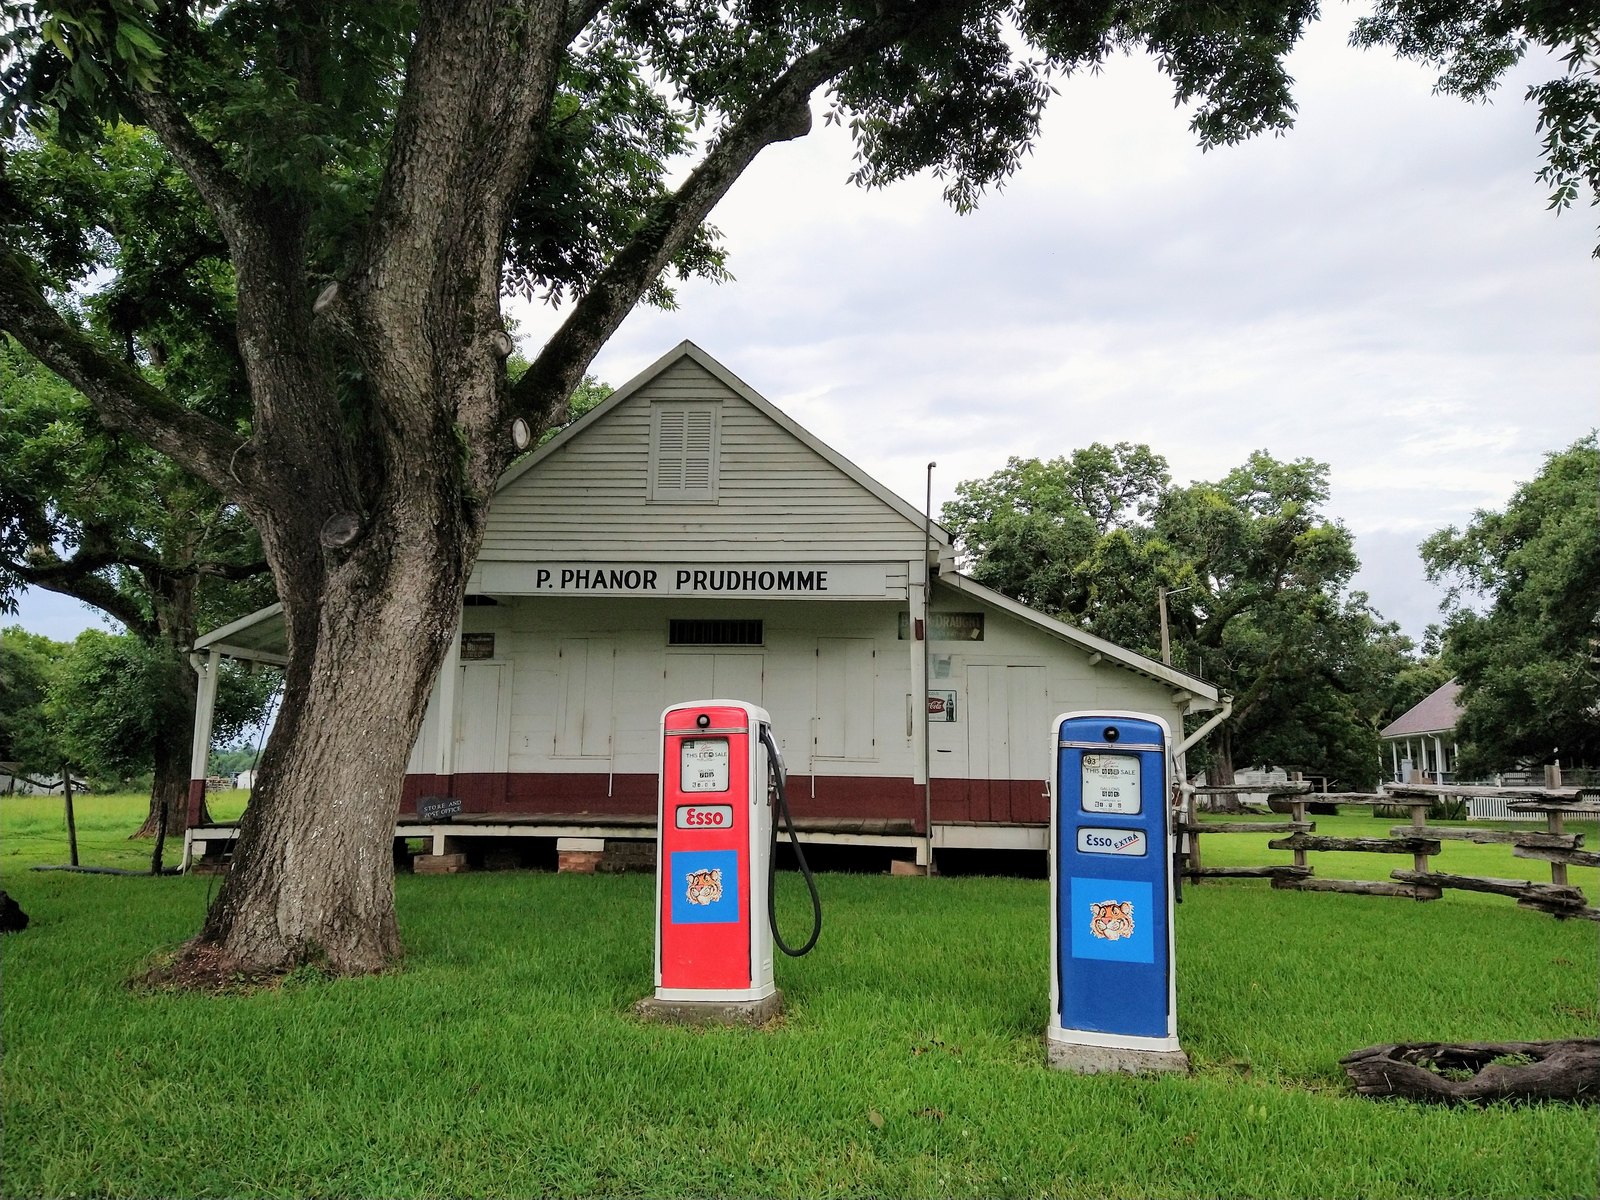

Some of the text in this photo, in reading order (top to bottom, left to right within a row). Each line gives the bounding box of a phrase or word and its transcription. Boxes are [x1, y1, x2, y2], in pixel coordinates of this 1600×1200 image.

[536, 569, 828, 591] P. PHANOR PRUDHOMME
[424, 803, 445, 812] STORE
[1113, 833, 1138, 849] EXTRA
